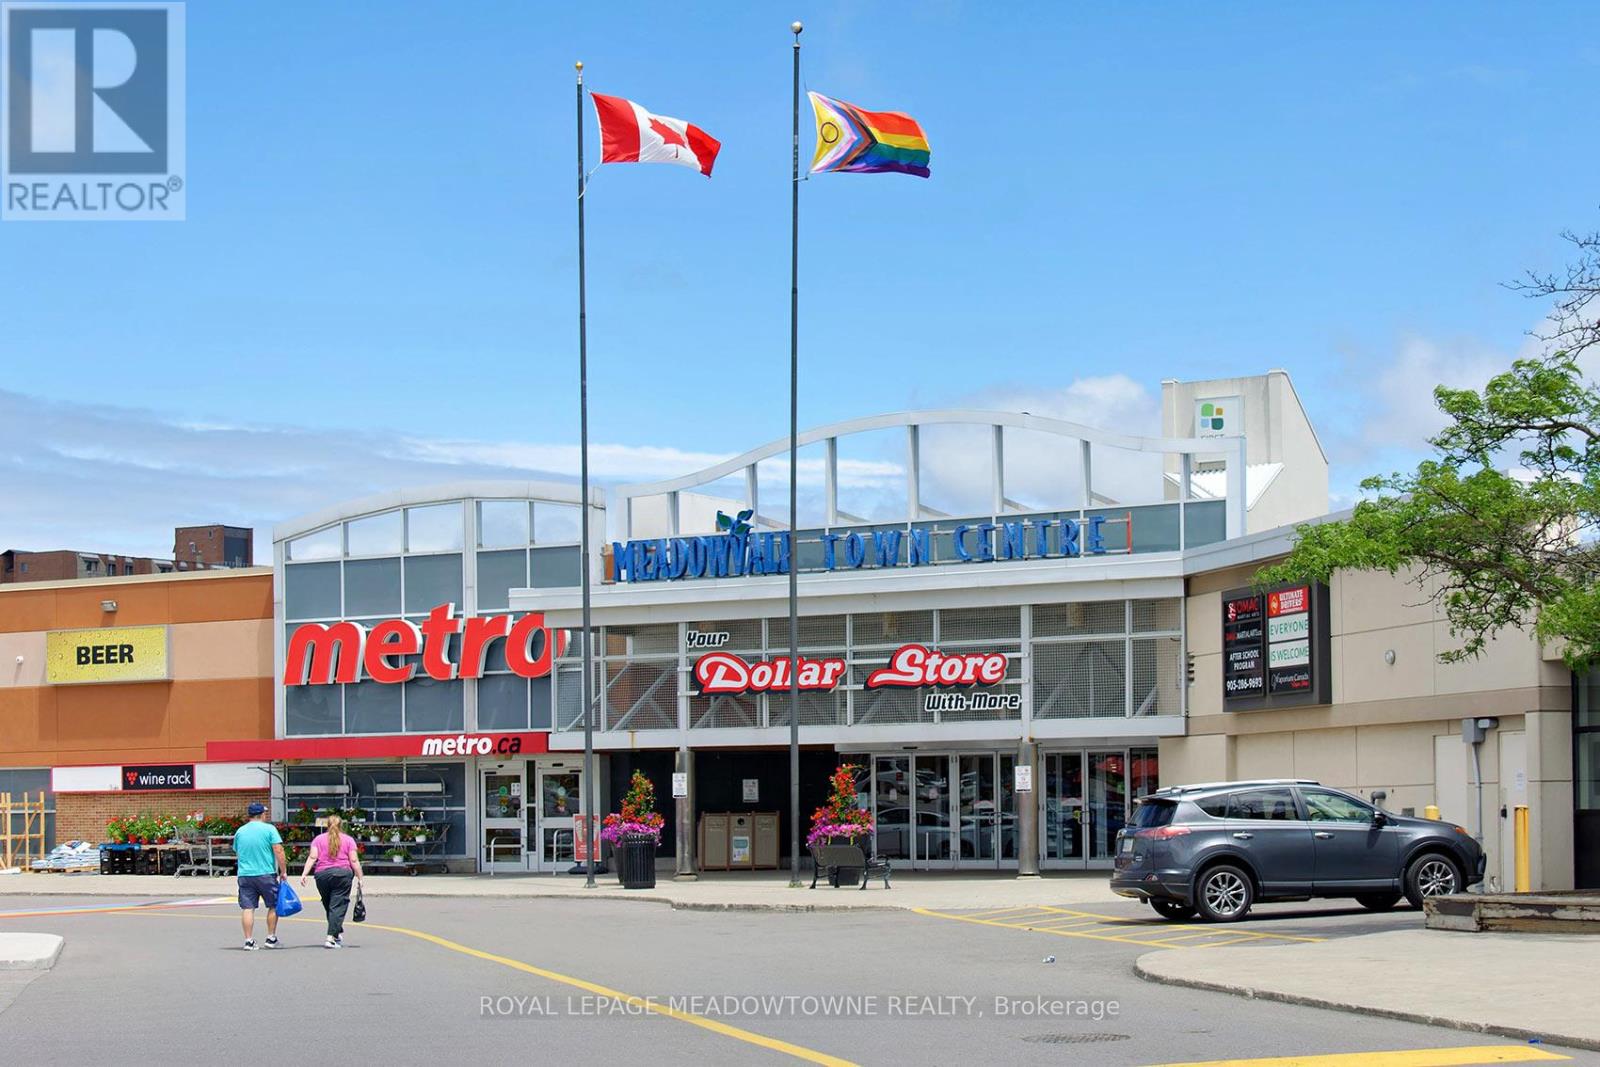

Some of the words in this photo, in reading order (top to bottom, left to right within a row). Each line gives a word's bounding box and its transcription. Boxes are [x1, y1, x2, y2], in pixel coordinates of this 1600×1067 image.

[822, 527, 929, 572] TOWN
[953, 515, 1106, 561] CENTRE
[1270, 619, 1309, 636] EVERYONE
[283, 602, 570, 686] metro
[687, 631, 729, 647] Your
[76, 644, 134, 665] BEER
[1229, 652, 1242, 661] AFTER
[1242, 650, 1259, 660] SCHOOL
[1276, 646, 1309, 661] WELCOME
[871, 646, 1005, 684] Store
[1234, 660, 1255, 671] PROGRAM
[926, 694, 966, 711] With
[970, 692, 1020, 710] More
[421, 734, 521, 756] metro.ca
[139, 772, 165, 785] wine
[167, 771, 191, 785] rack
